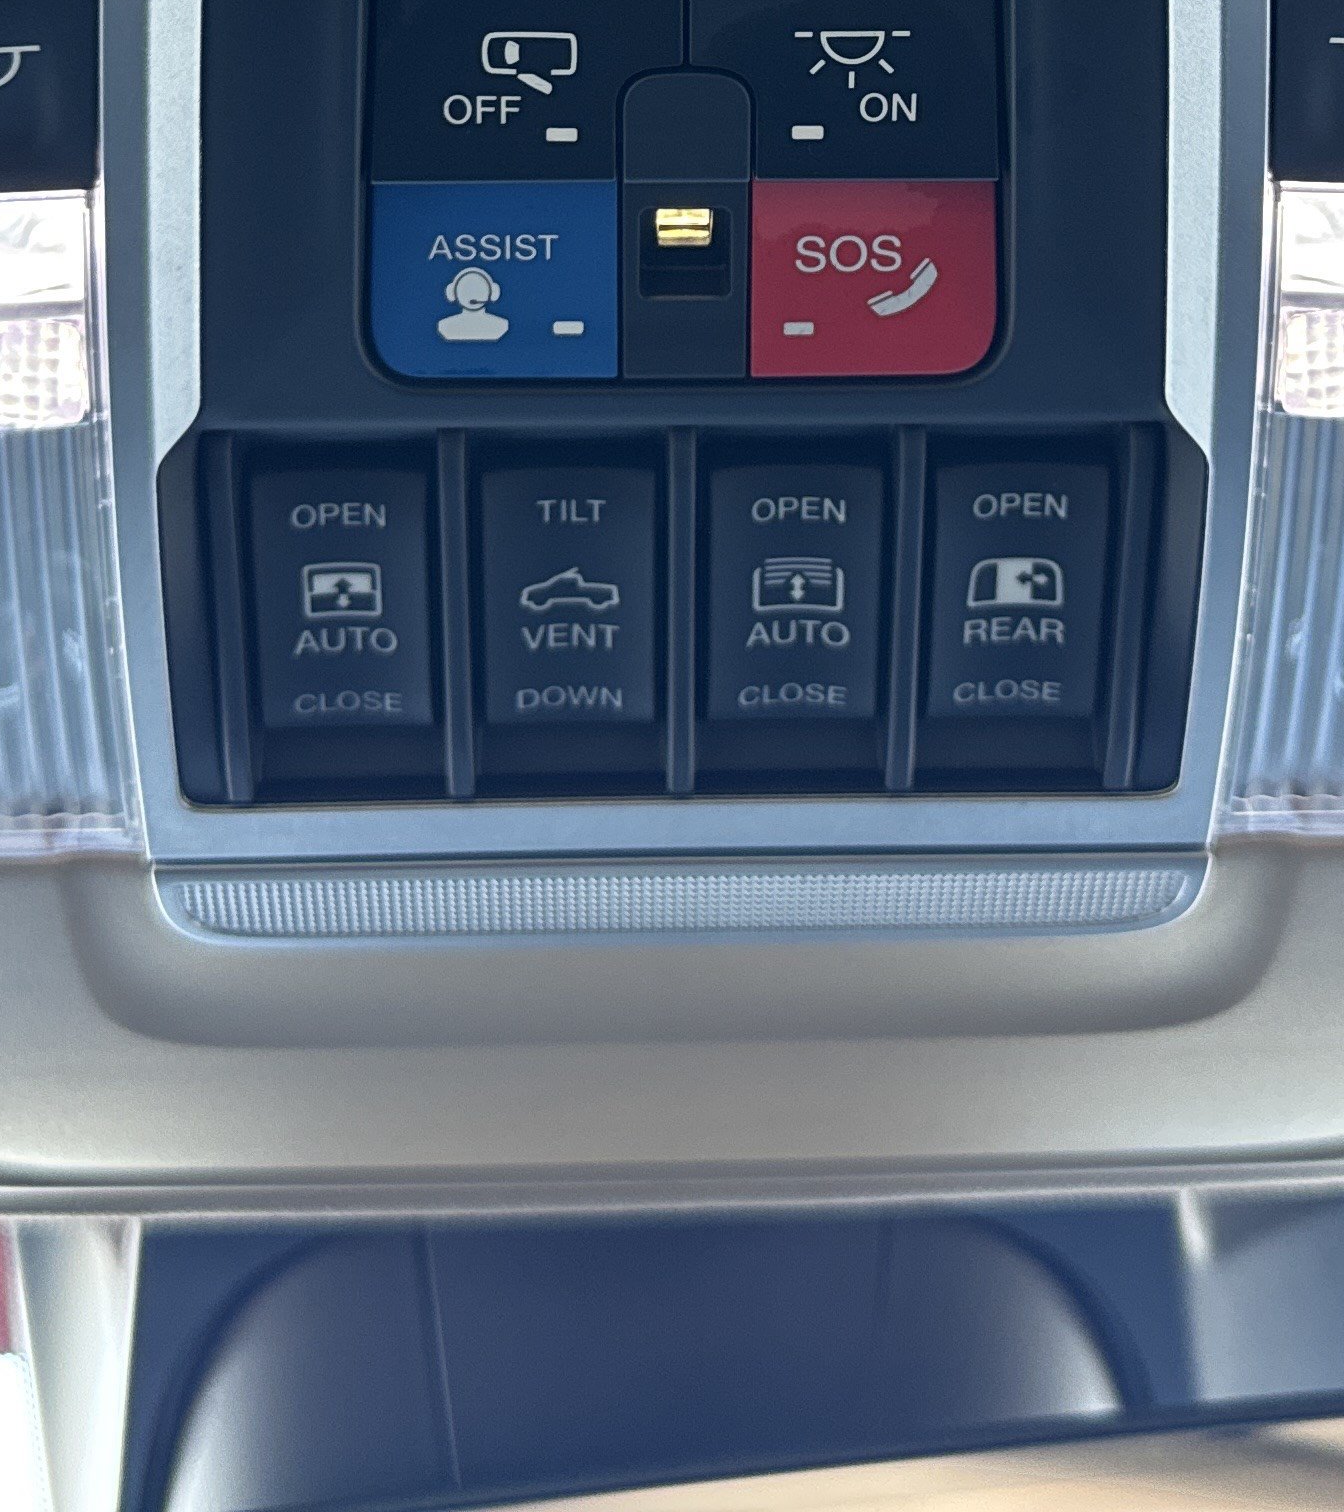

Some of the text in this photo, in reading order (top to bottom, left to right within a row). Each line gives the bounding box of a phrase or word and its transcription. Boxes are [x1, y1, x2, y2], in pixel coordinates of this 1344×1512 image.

[442, 95, 522, 125] OFF
[859, 93, 918, 123] ON
[427, 234, 560, 262] ASSIST
[794, 235, 903, 274] SOS
[291, 503, 387, 531] OPEN
[536, 498, 607, 525] TILT
[751, 496, 847, 525] OPEN
[971, 492, 1069, 521] OPEN
[294, 626, 398, 657] AUTO
[522, 623, 621, 652] VENT
[745, 619, 850, 649] AUTO
[962, 617, 1066, 646] REAR
[293, 691, 403, 714] CLOSE
[516, 685, 623, 712] DOWN
[738, 683, 848, 708] CLOSE
[953, 679, 1062, 705] CLOSE
